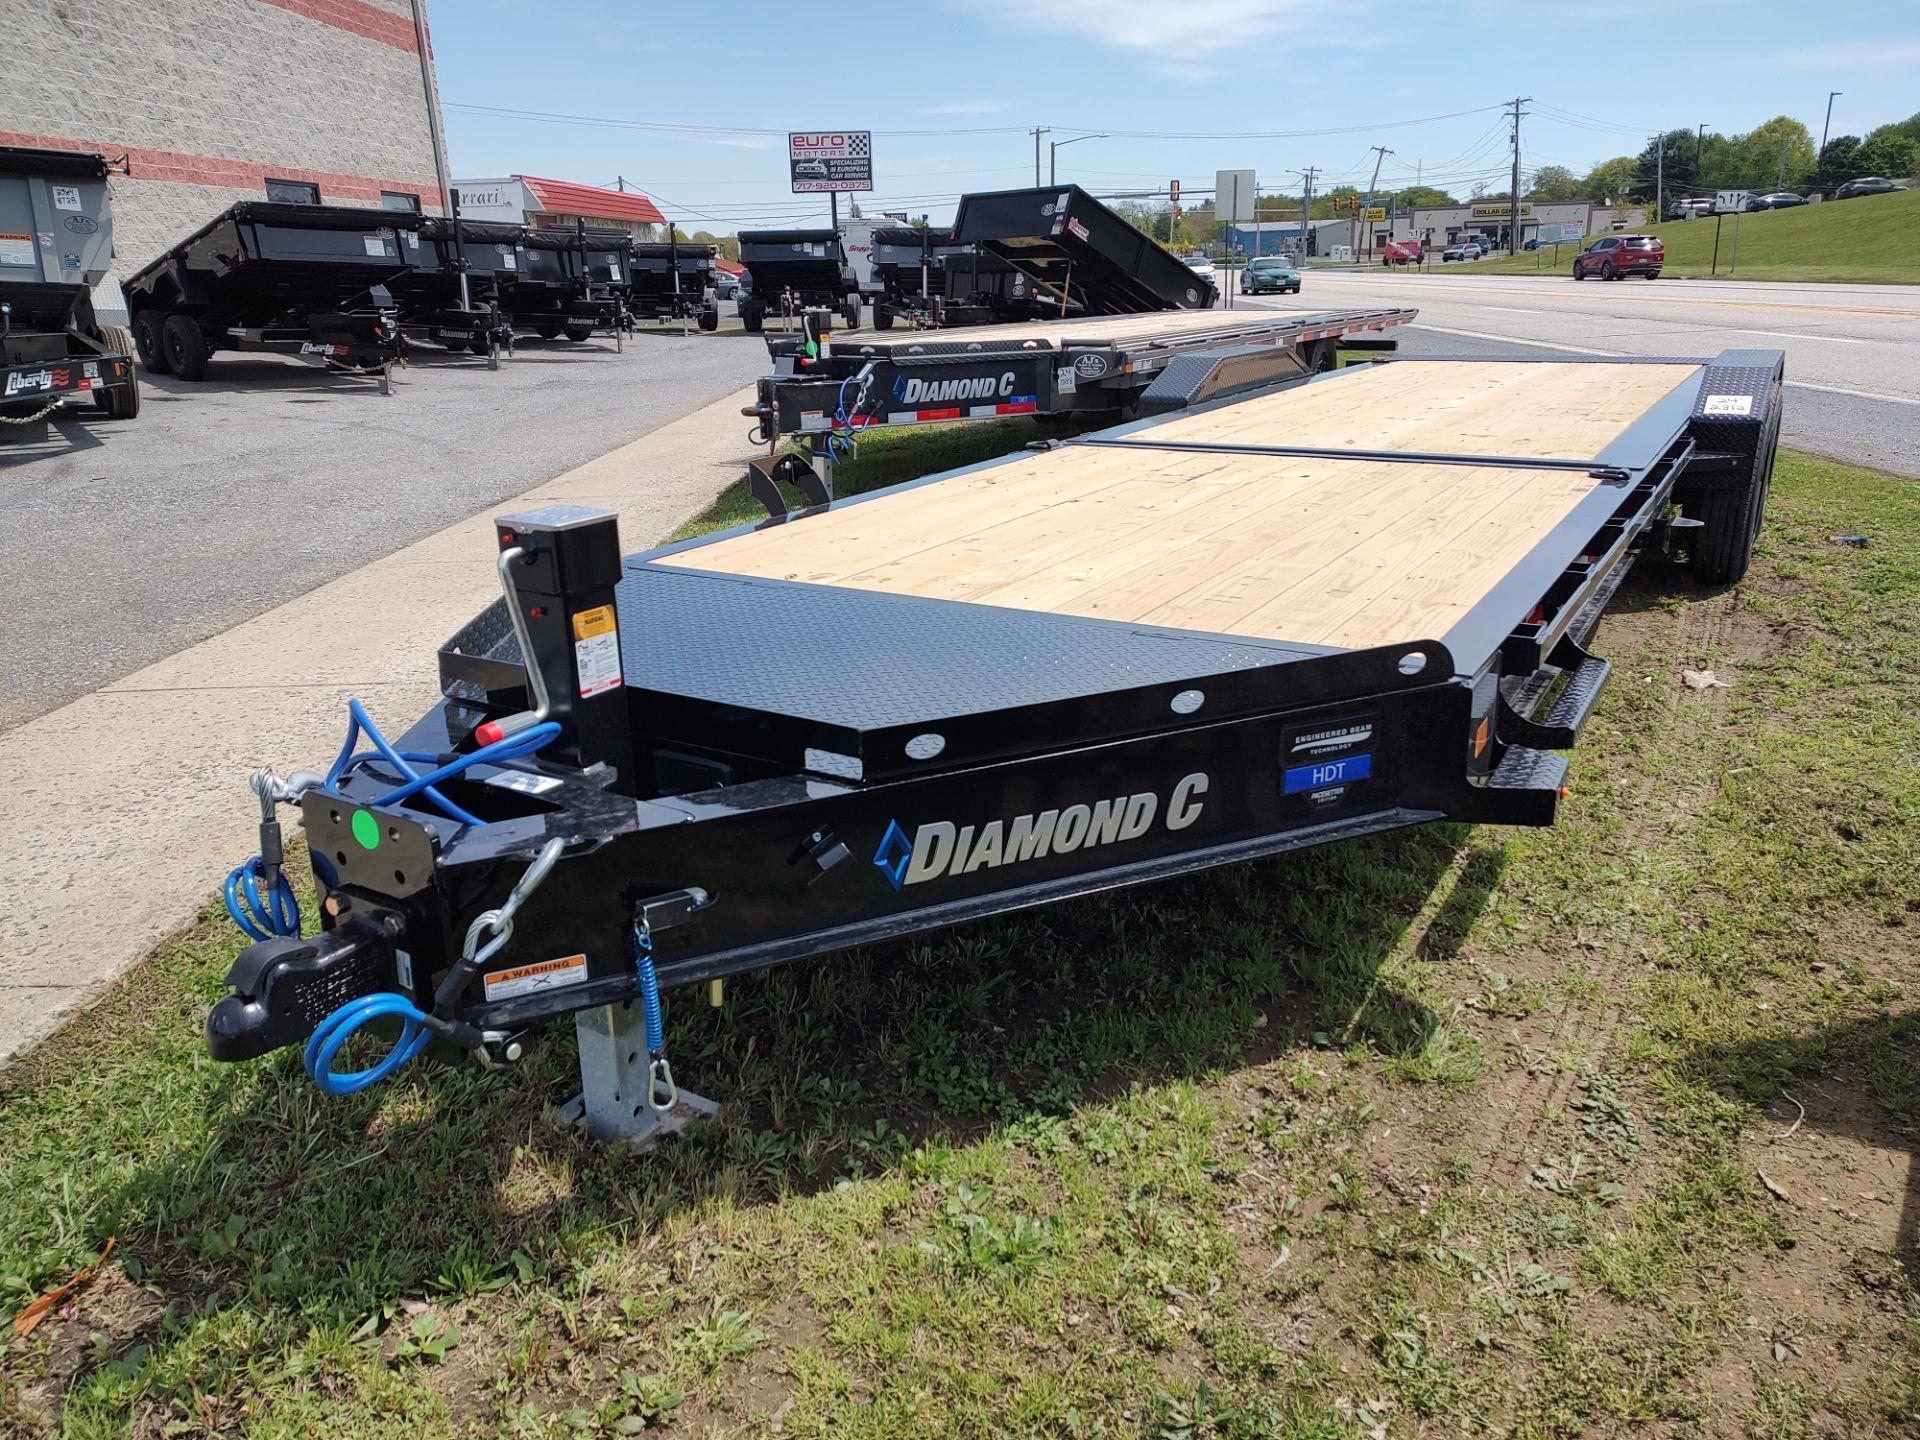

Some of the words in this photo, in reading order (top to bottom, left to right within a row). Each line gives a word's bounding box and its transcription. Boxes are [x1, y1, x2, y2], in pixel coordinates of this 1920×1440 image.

[792, 135, 845, 147] euro
[795, 182, 869, 190] 717-920-0375
[462, 188, 498, 204] rrari
[300, 342, 335, 355] Liberty
[5, 369, 53, 396] Liberty
[903, 377, 997, 404] DIAMOND
[998, 371, 1016, 397] C
[1295, 728, 1348, 744] ENGINEERED
[1349, 723, 1373, 734] BEAM
[1310, 743, 1352, 755] TECHNOLOGY
[1312, 763, 1346, 784] HDT
[903, 791, 1158, 886] DIAMOND
[1165, 772, 1209, 831] C
[512, 960, 570, 977] WARNING
